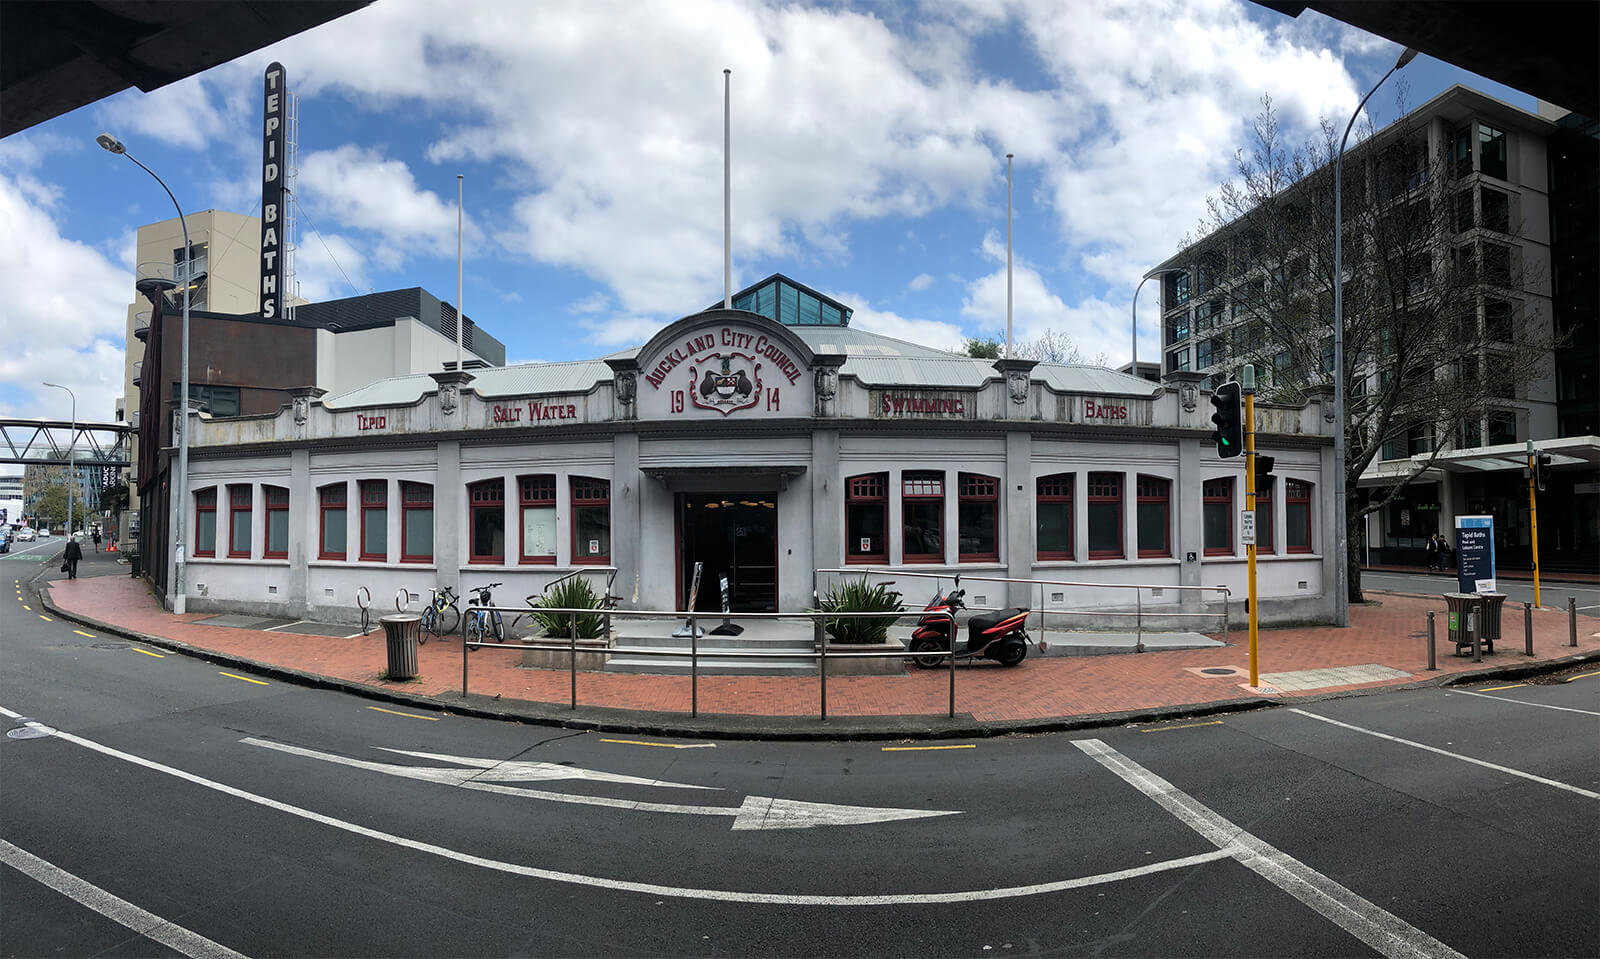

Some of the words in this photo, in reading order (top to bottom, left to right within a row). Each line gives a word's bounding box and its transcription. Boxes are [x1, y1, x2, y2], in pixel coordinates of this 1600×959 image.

[265, 70, 280, 183] TEPID
[263, 204, 278, 318] BATHS
[645, 333, 715, 390] AUCKLAND
[721, 328, 754, 349] CITY
[755, 335, 802, 386] COUNCIL
[670, 390, 684, 413] 19
[766, 387, 780, 412] 14
[882, 394, 964, 414] SWIMMING
[1084, 400, 1128, 420] BATHS
[357, 414, 386, 431] TEPID
[493, 405, 522, 423] SALT
[528, 402, 577, 421] WATER
[1462, 531, 1473, 539] Tepid
